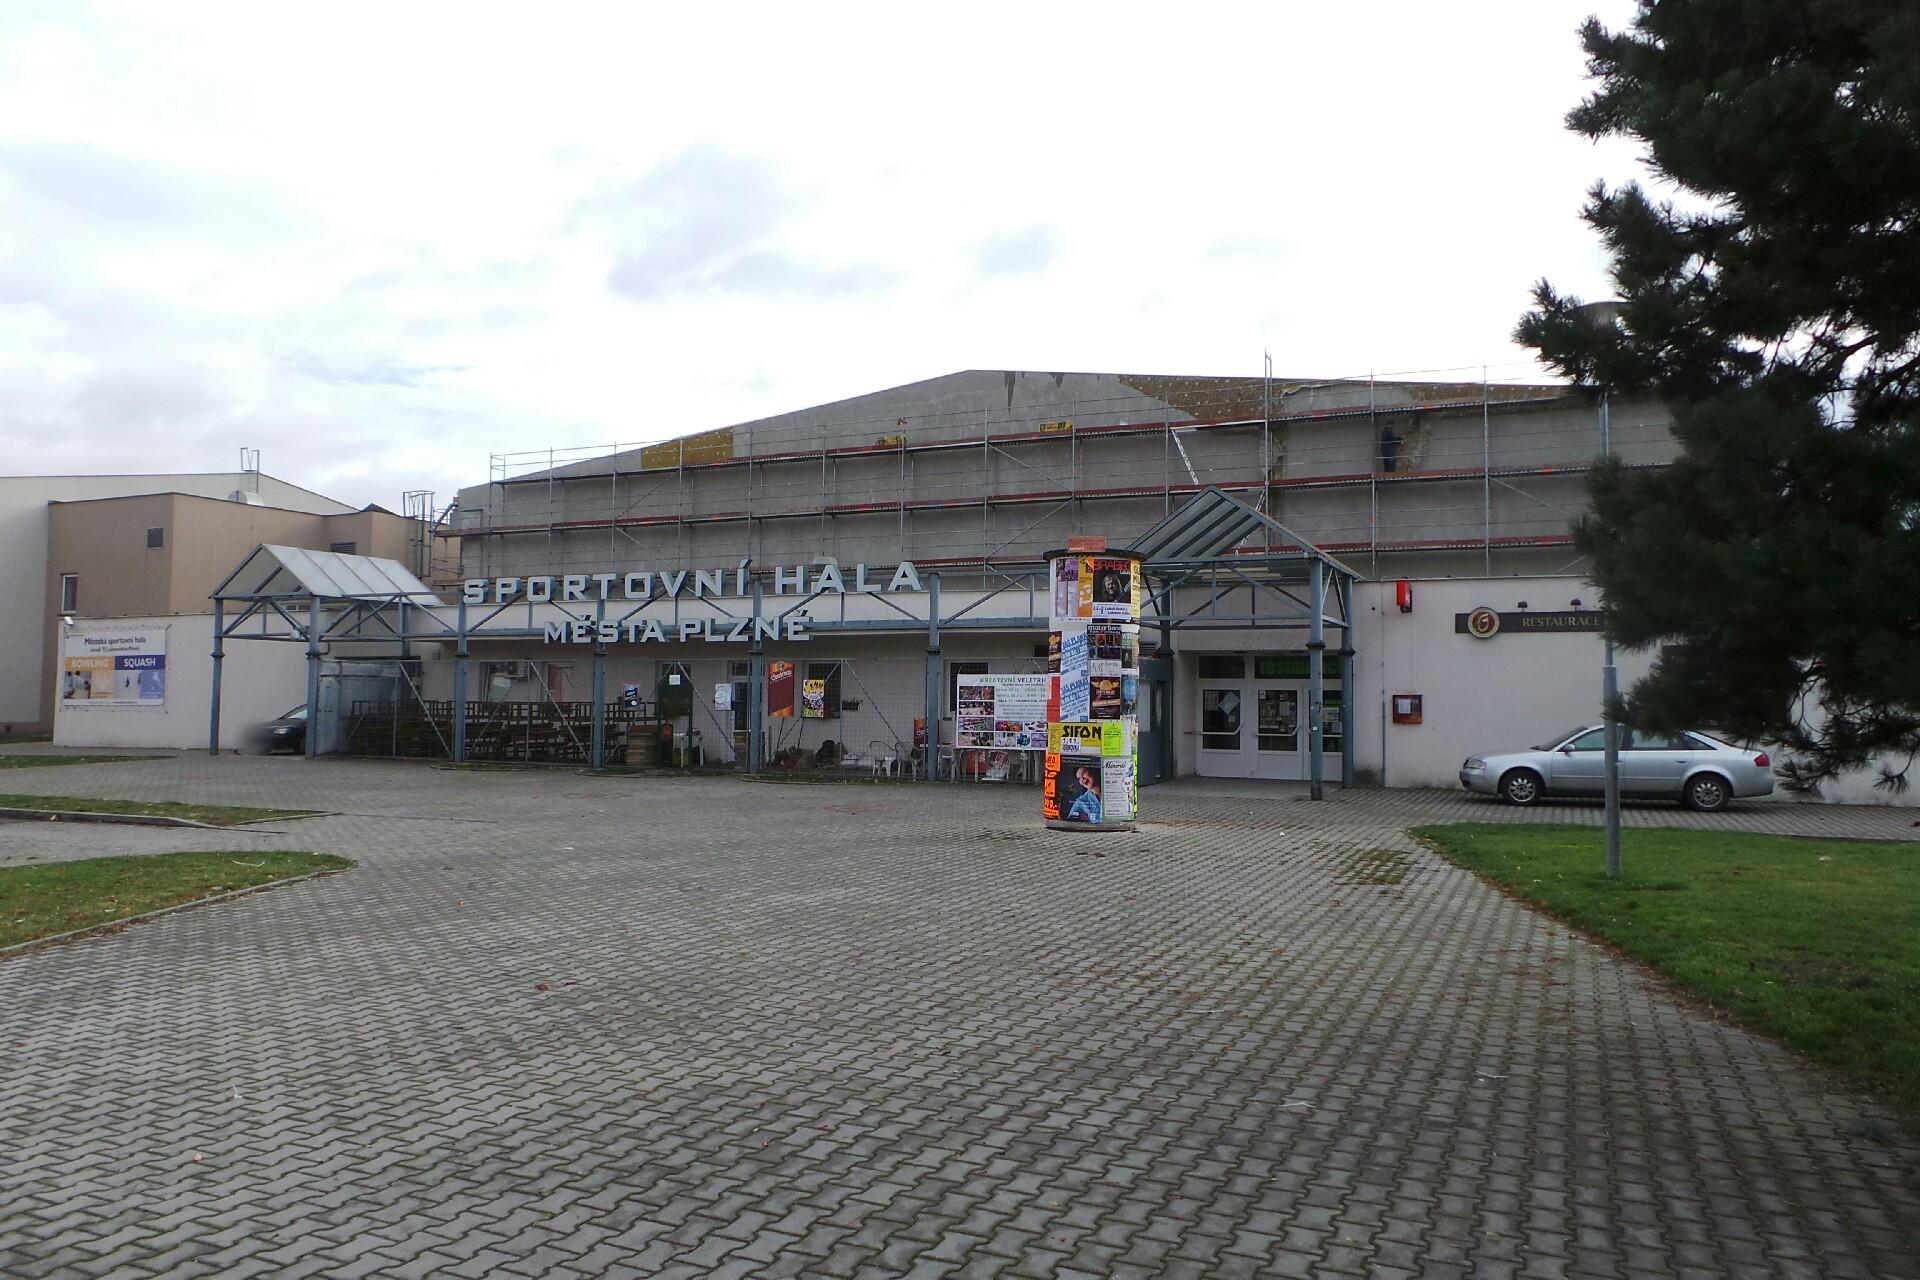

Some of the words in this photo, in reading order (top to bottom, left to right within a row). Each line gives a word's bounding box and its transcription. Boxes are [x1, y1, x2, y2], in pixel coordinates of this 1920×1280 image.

[463, 558, 752, 604] SPORTOVNÍ
[775, 561, 924, 595] HALA
[544, 614, 672, 644] MĚSTA
[680, 609, 814, 643] PLZNĚ
[1522, 616, 1601, 627] RESTAURACE
[123, 657, 156, 668] SQUASH
[1060, 725, 1102, 740] SIFON
